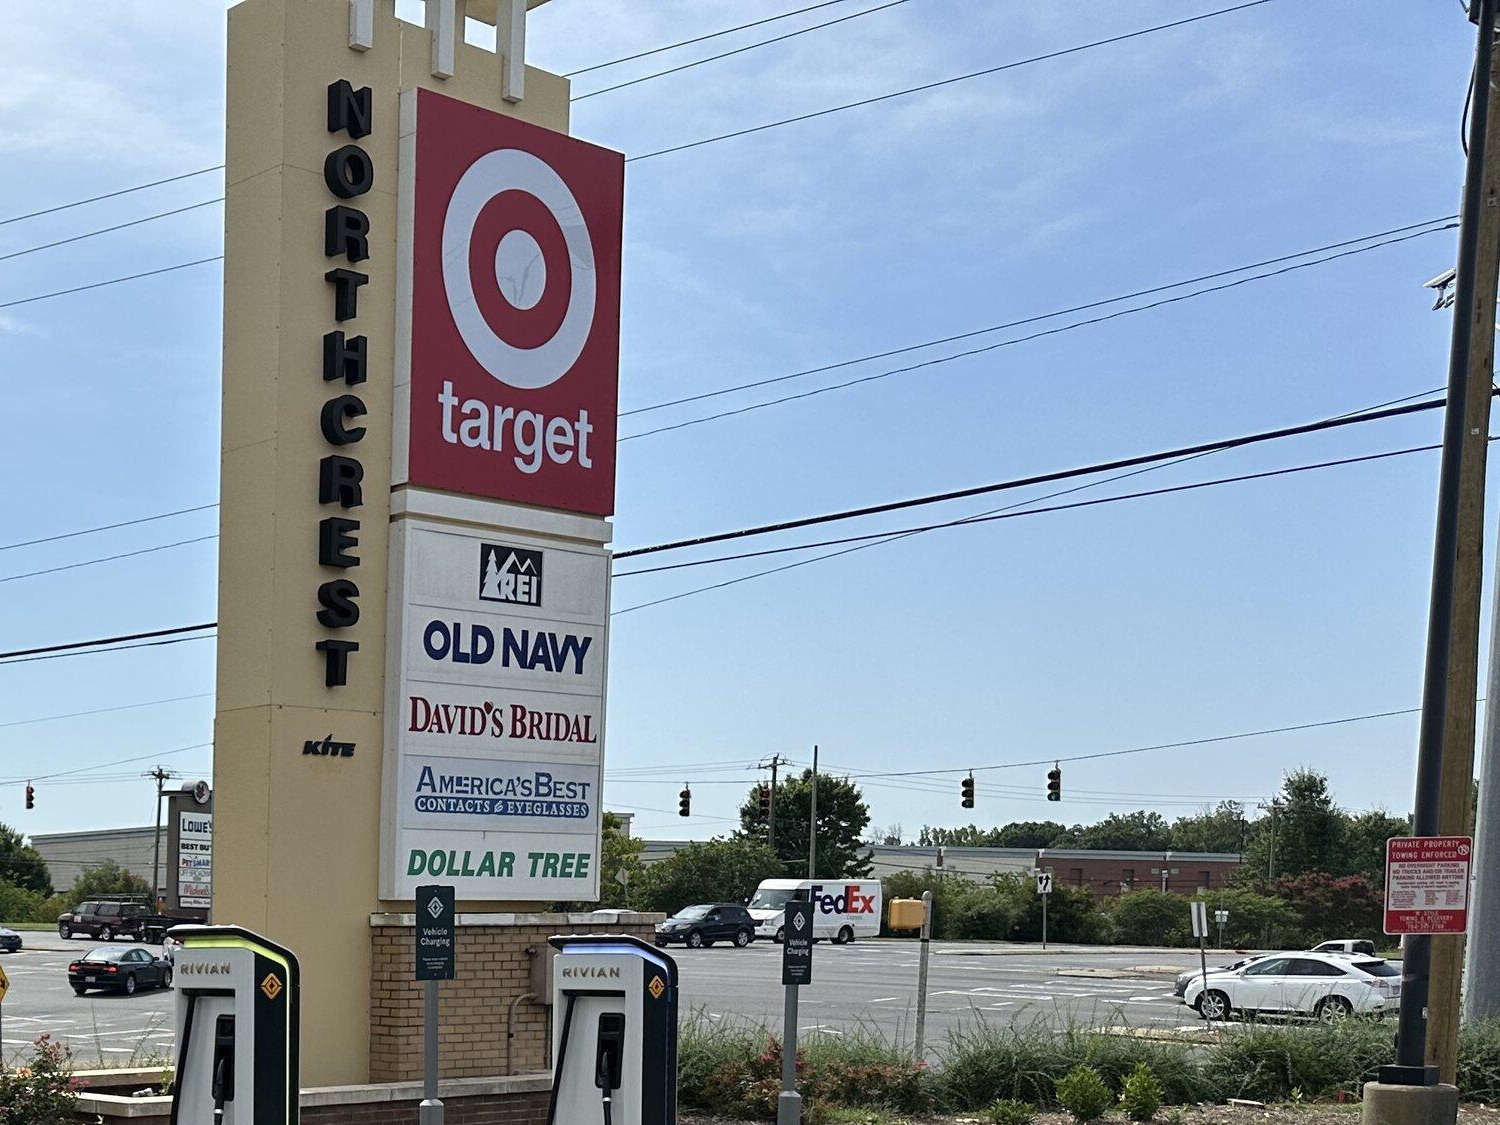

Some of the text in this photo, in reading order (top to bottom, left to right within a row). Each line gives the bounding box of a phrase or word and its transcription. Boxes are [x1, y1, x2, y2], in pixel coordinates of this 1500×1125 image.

[315, 79, 374, 687] NORTHCREST
[438, 381, 593, 474] target
[502, 573, 537, 603] REI
[423, 620, 592, 674] OLD NAVY
[409, 696, 597, 743] DAVID'S BRIDAL
[416, 766, 590, 799] AMERICA'S BEST
[417, 798, 490, 813] CONTACTS
[507, 802, 588, 817] EYEGLASSES
[1421, 851, 1457, 859] ENFORCED
[1424, 840, 1460, 848] PROPERTY
[407, 850, 590, 878] DOLLAR TREE
[810, 885, 875, 914] FedEx
[420, 937, 450, 947] Charging
[422, 927, 448, 936] Vehicle
[788, 938, 808, 946] Vehicle
[180, 962, 231, 975] RIVIAN
[562, 966, 620, 978] RIVIAN
